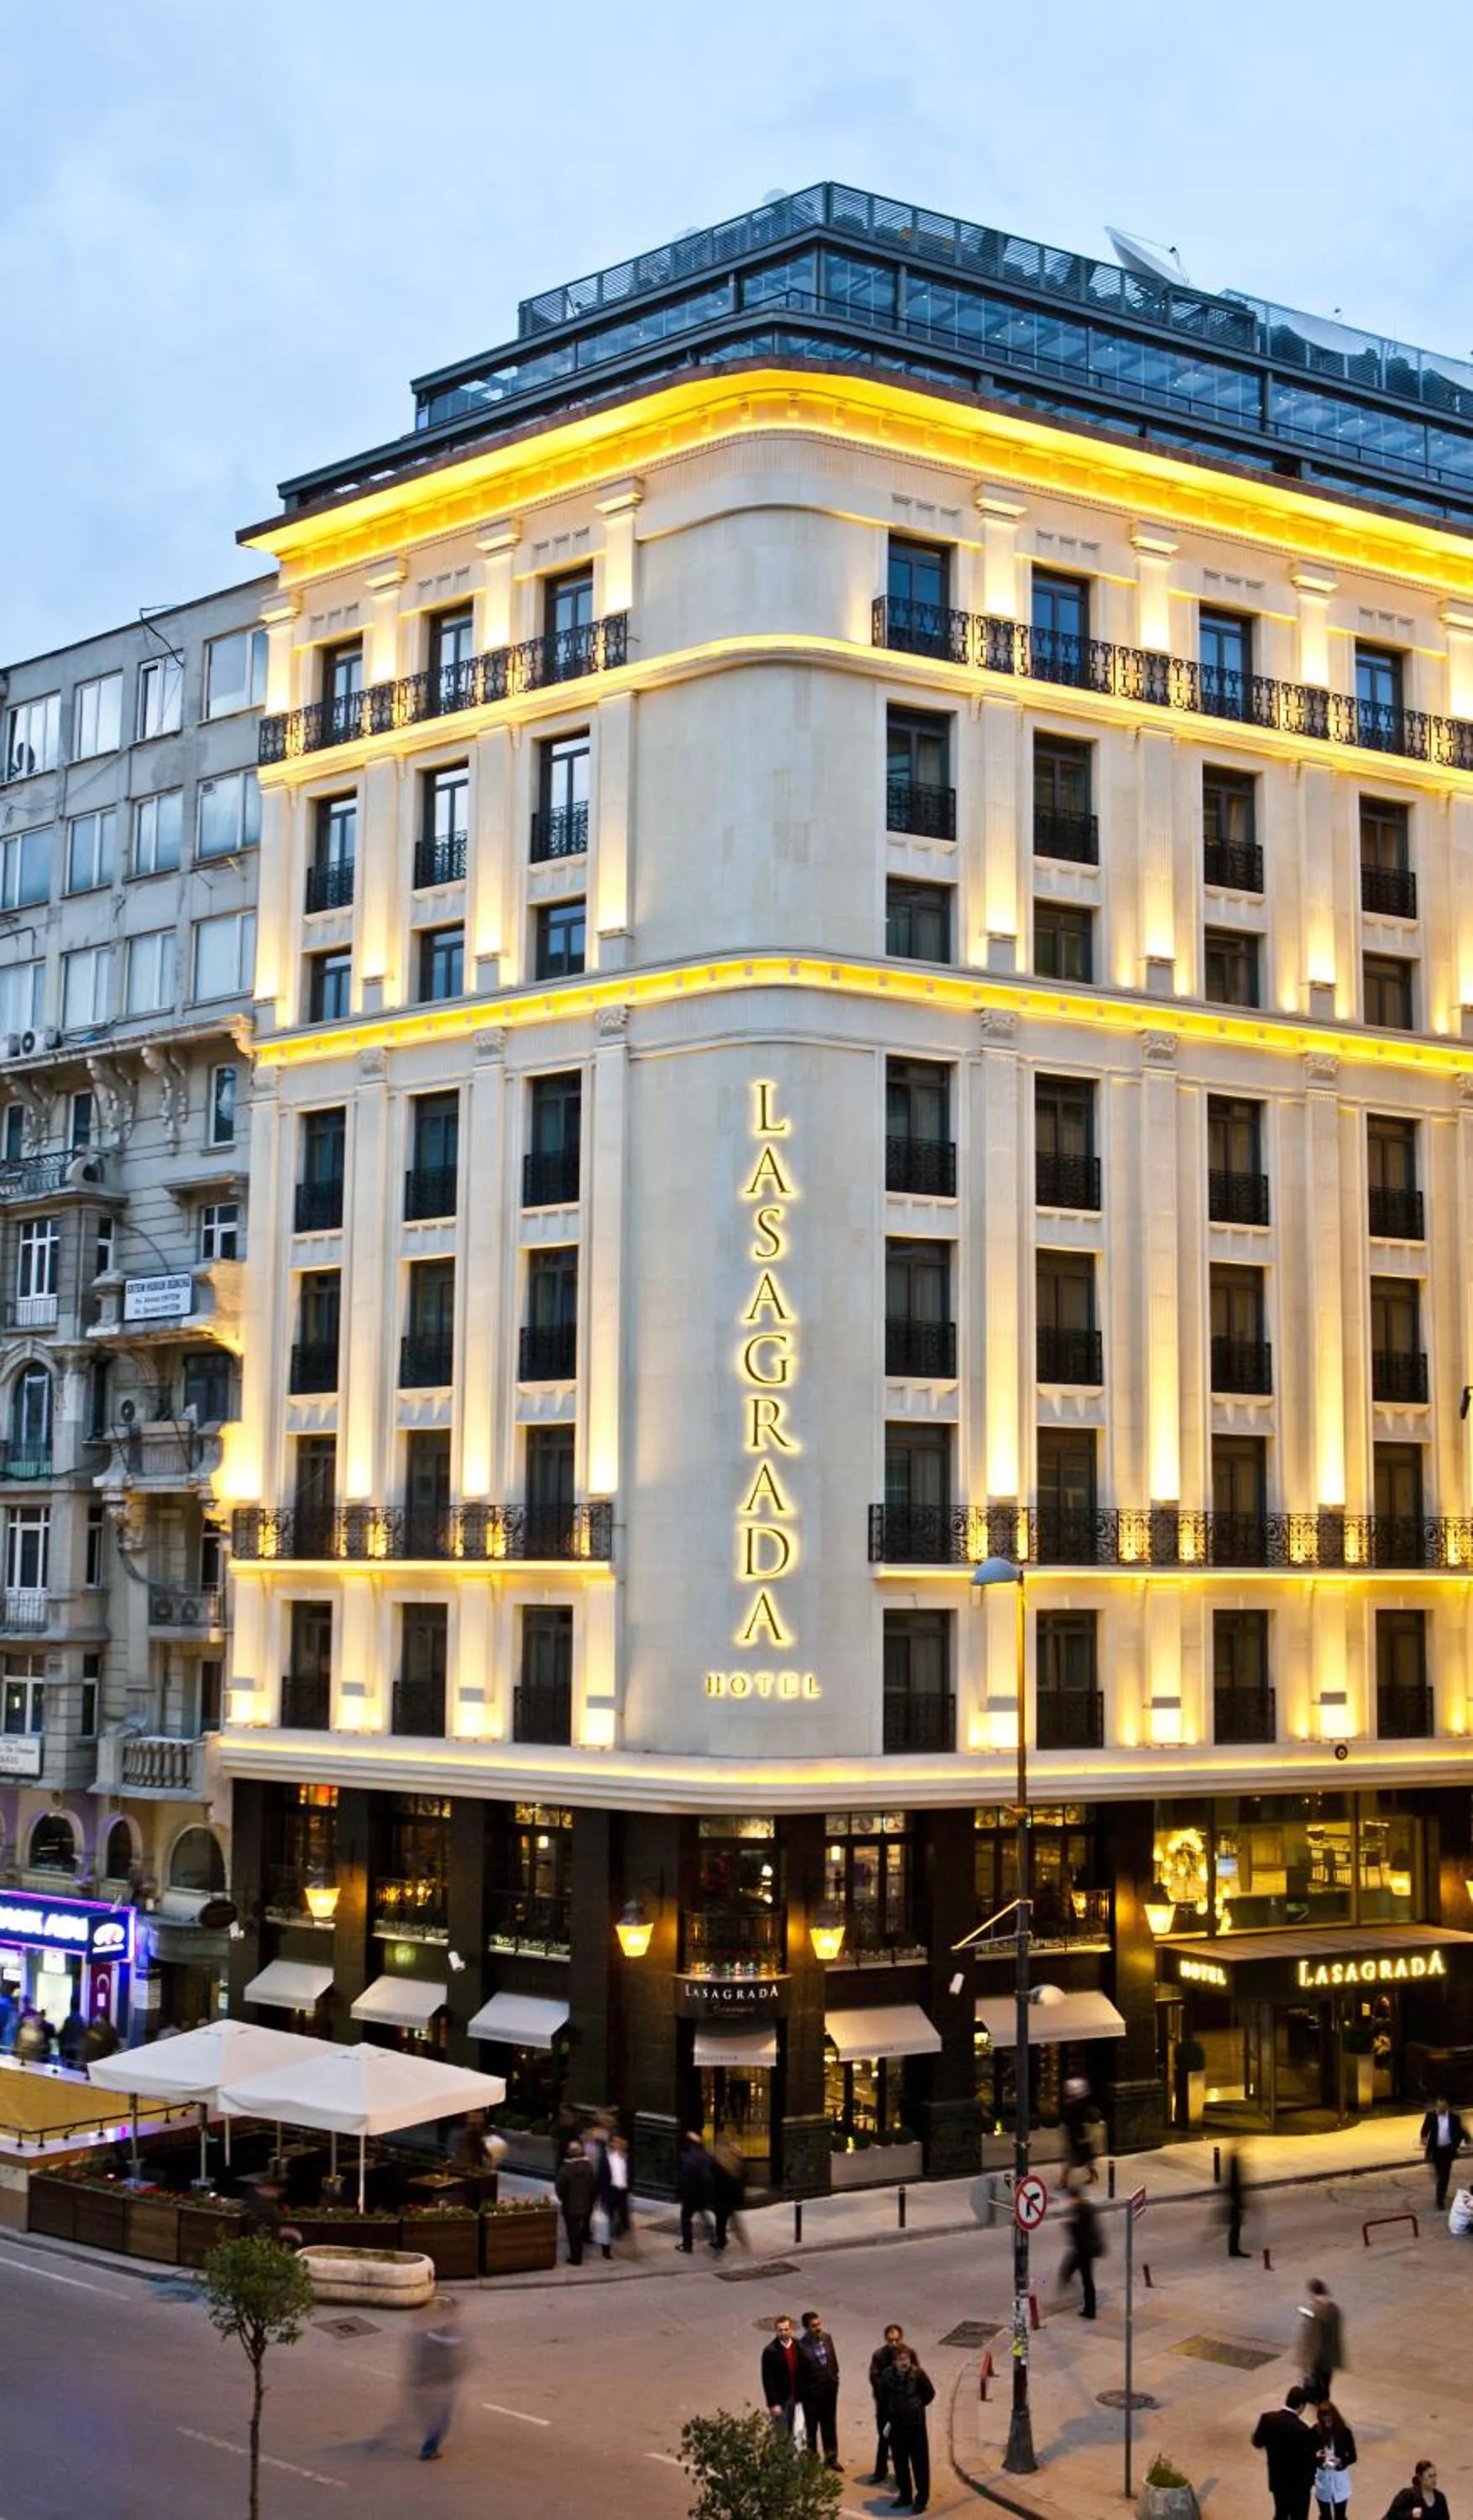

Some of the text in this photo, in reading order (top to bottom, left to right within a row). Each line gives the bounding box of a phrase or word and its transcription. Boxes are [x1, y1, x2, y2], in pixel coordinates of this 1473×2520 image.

[740, 1081, 794, 1644] LASAGRADA
[706, 1673, 821, 1696] HOTEL
[1179, 1960, 1227, 1986] HOTEL
[1298, 1949, 1446, 1987] LASAGRADA
[684, 1983, 778, 2000] LASAGRADA
